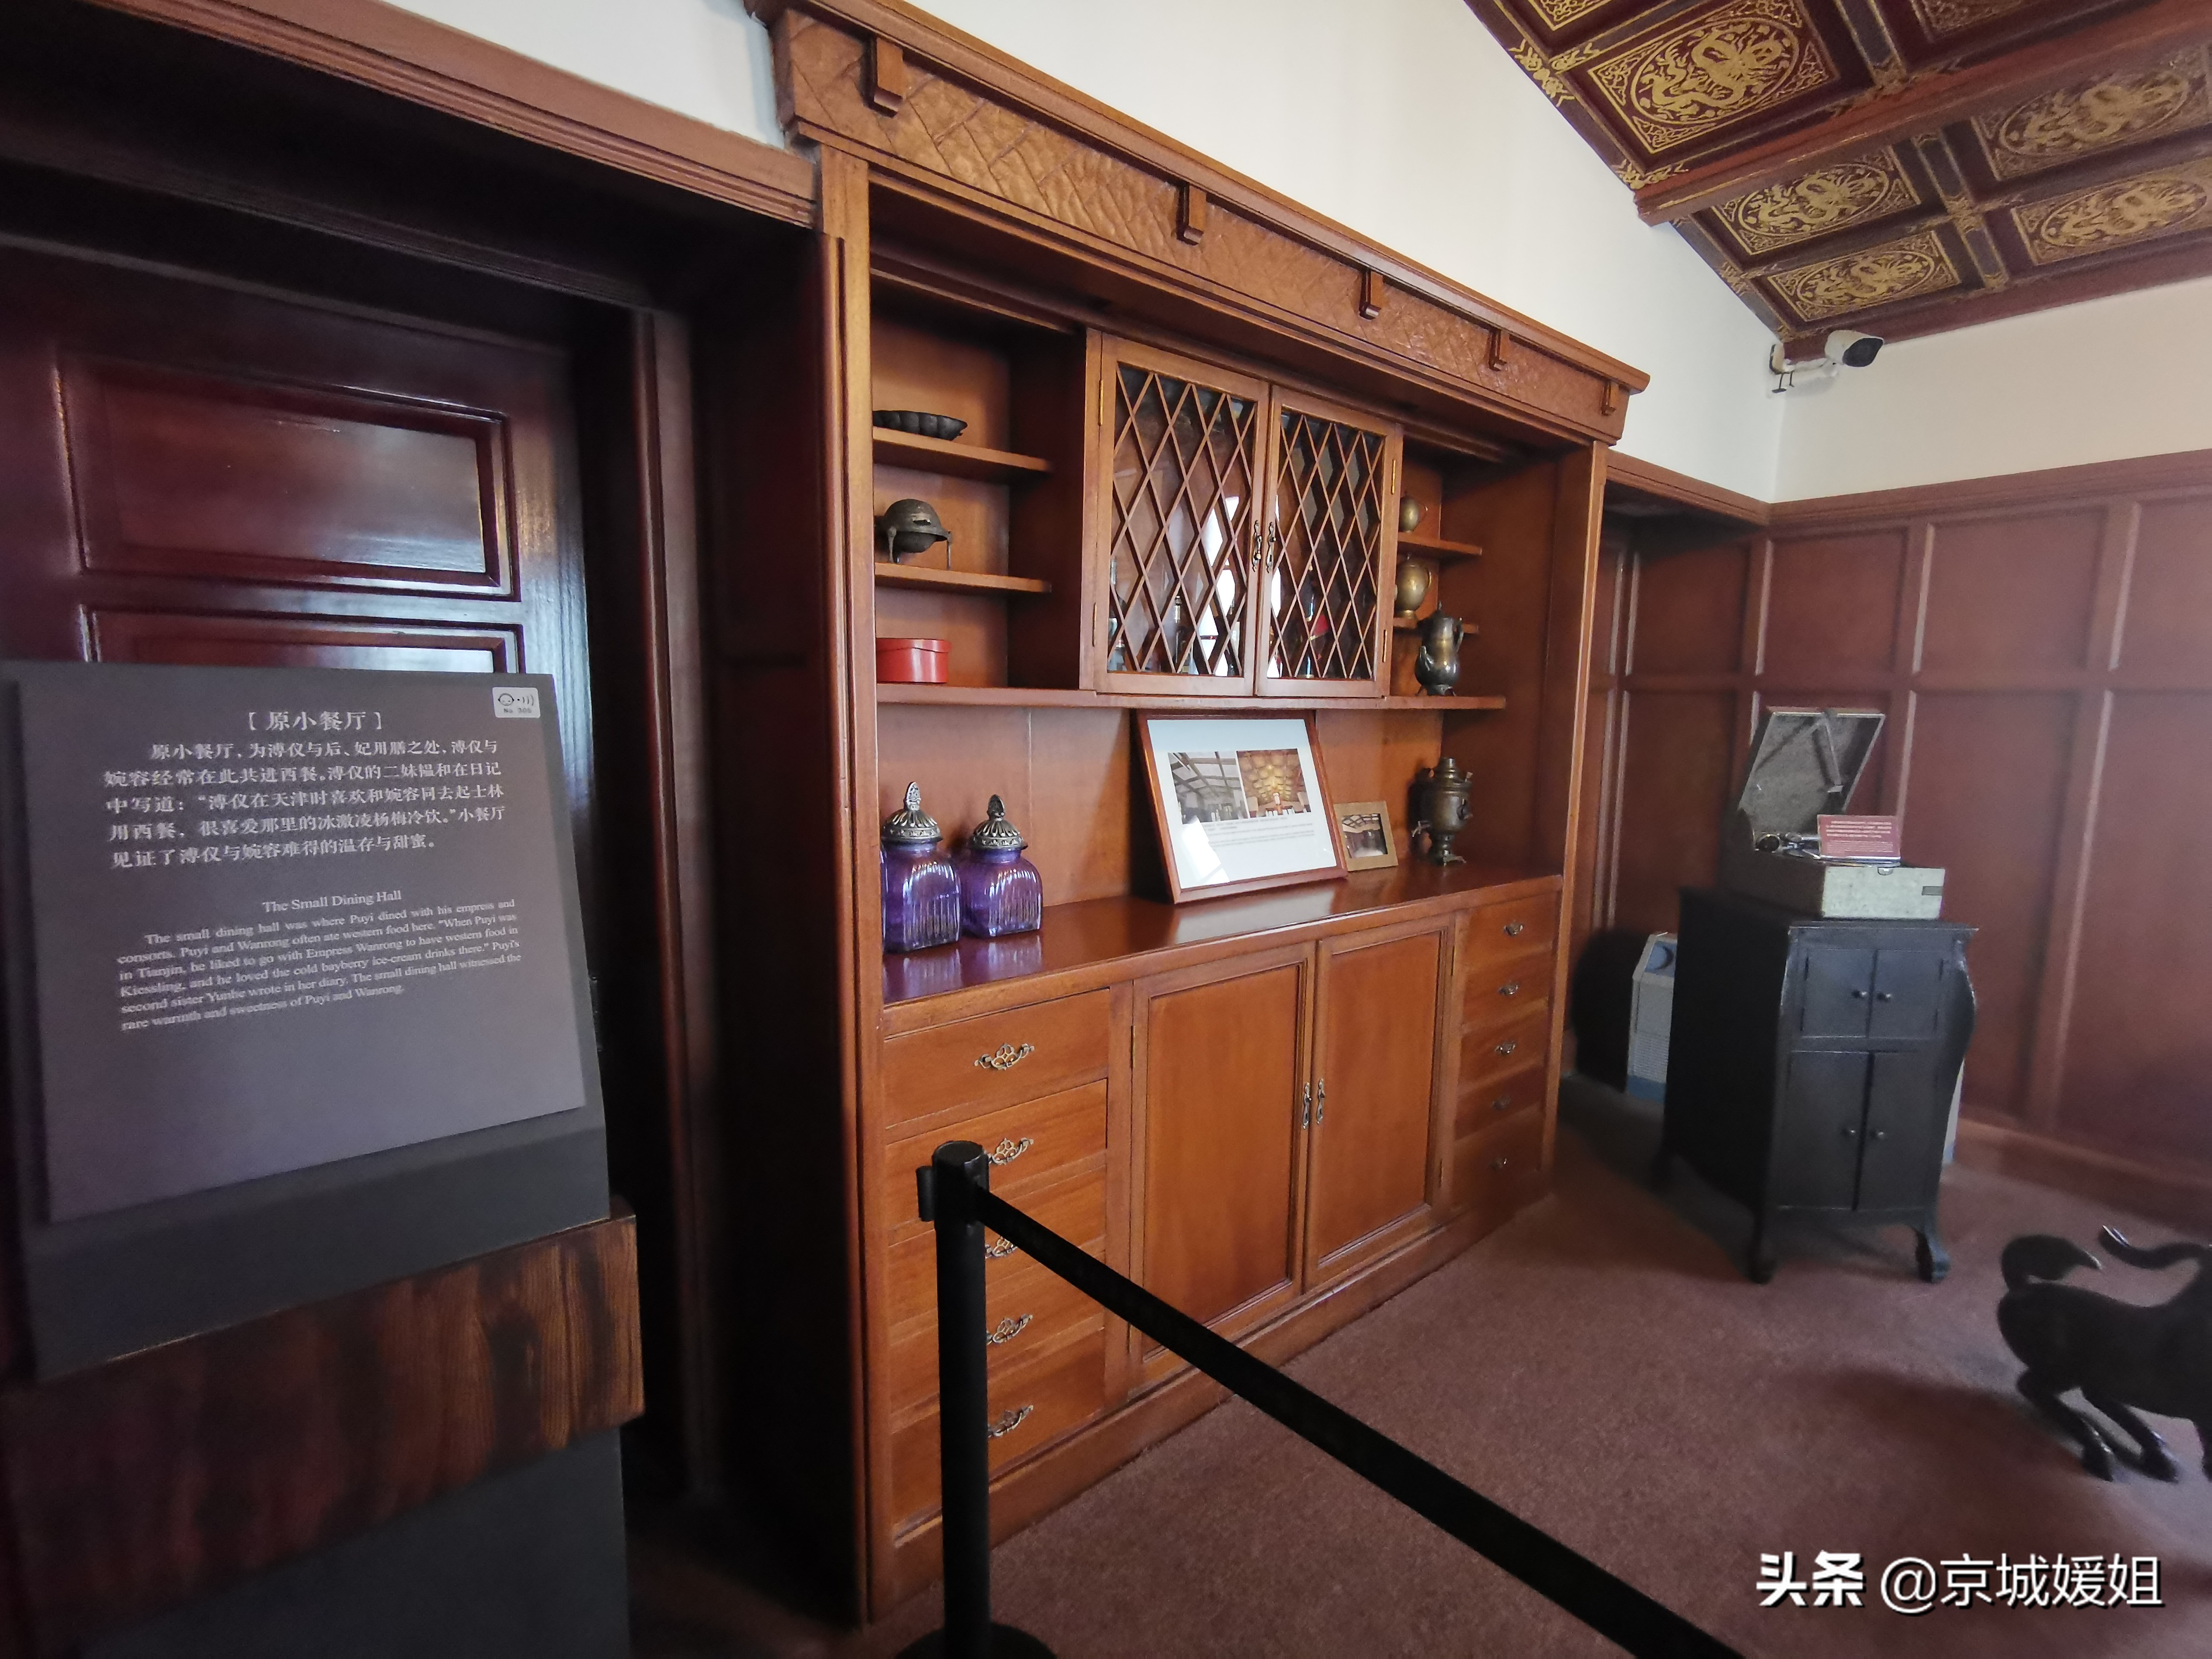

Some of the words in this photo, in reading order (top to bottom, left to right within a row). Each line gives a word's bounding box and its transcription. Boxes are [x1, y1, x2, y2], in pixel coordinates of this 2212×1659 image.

[144, 934, 171, 944] The
[176, 928, 210, 941] small
[216, 928, 254, 937] dining
[258, 922, 279, 933] hall
[311, 917, 345, 927] where
[350, 913, 374, 924] Puyi
[378, 909, 407, 920] dined
[411, 907, 433, 917] with
[438, 906, 452, 915] his
[456, 903, 494, 915] empress
[498, 899, 514, 908] and
[262, 901, 288, 912] The
[292, 896, 328, 909] Small
[332, 893, 374, 906] Dining
[377, 890, 401, 902] Hall
[120, 972, 132, 980] in
[191, 962, 205, 972] he
[210, 957, 239, 969] liked
[260, 955, 273, 966] go
[278, 950, 302, 961] with
[306, 947, 353, 959] Empress
[356, 941, 403, 952] Wanrong
[418, 936, 442, 945] have
[445, 931, 482, 942] western
[485, 927, 505, 938] food
[181, 947, 208, 957] Puyi
[212, 942, 234, 953] and
[238, 940, 290, 950] Wanrong
[292, 934, 321, 944] often
[343, 928, 383, 938] western
[386, 924, 409, 934] food
[475, 915, 495, 925] Puyi
[121, 998, 168, 1014] second
[171, 996, 203, 1007] sister
[248, 986, 281, 995] wrote
[283, 982, 295, 992] in
[298, 981, 317, 989] her
[353, 973, 372, 982] The
[374, 968, 402, 980] small
[405, 966, 436, 976] dining
[438, 961, 457, 971] hall
[459, 954, 505, 968] witnessed
[507, 954, 521, 962] the
[189, 977, 213, 988] and
[217, 975, 232, 985] he
[236, 969, 268, 982] loved
[272, 968, 289, 978] the
[294, 964, 318, 975] cold
[322, 960, 369, 973] bayberry
[372, 953, 421, 966] ice-cream
[425, 948, 455, 958] drinks
[121, 1019, 149, 1031] rare
[152, 1010, 201, 1025] warmth
[203, 1006, 228, 1018] and
[290, 997, 302, 1007] of
[305, 995, 330, 1005] Puyi
[333, 990, 352, 1001] and
